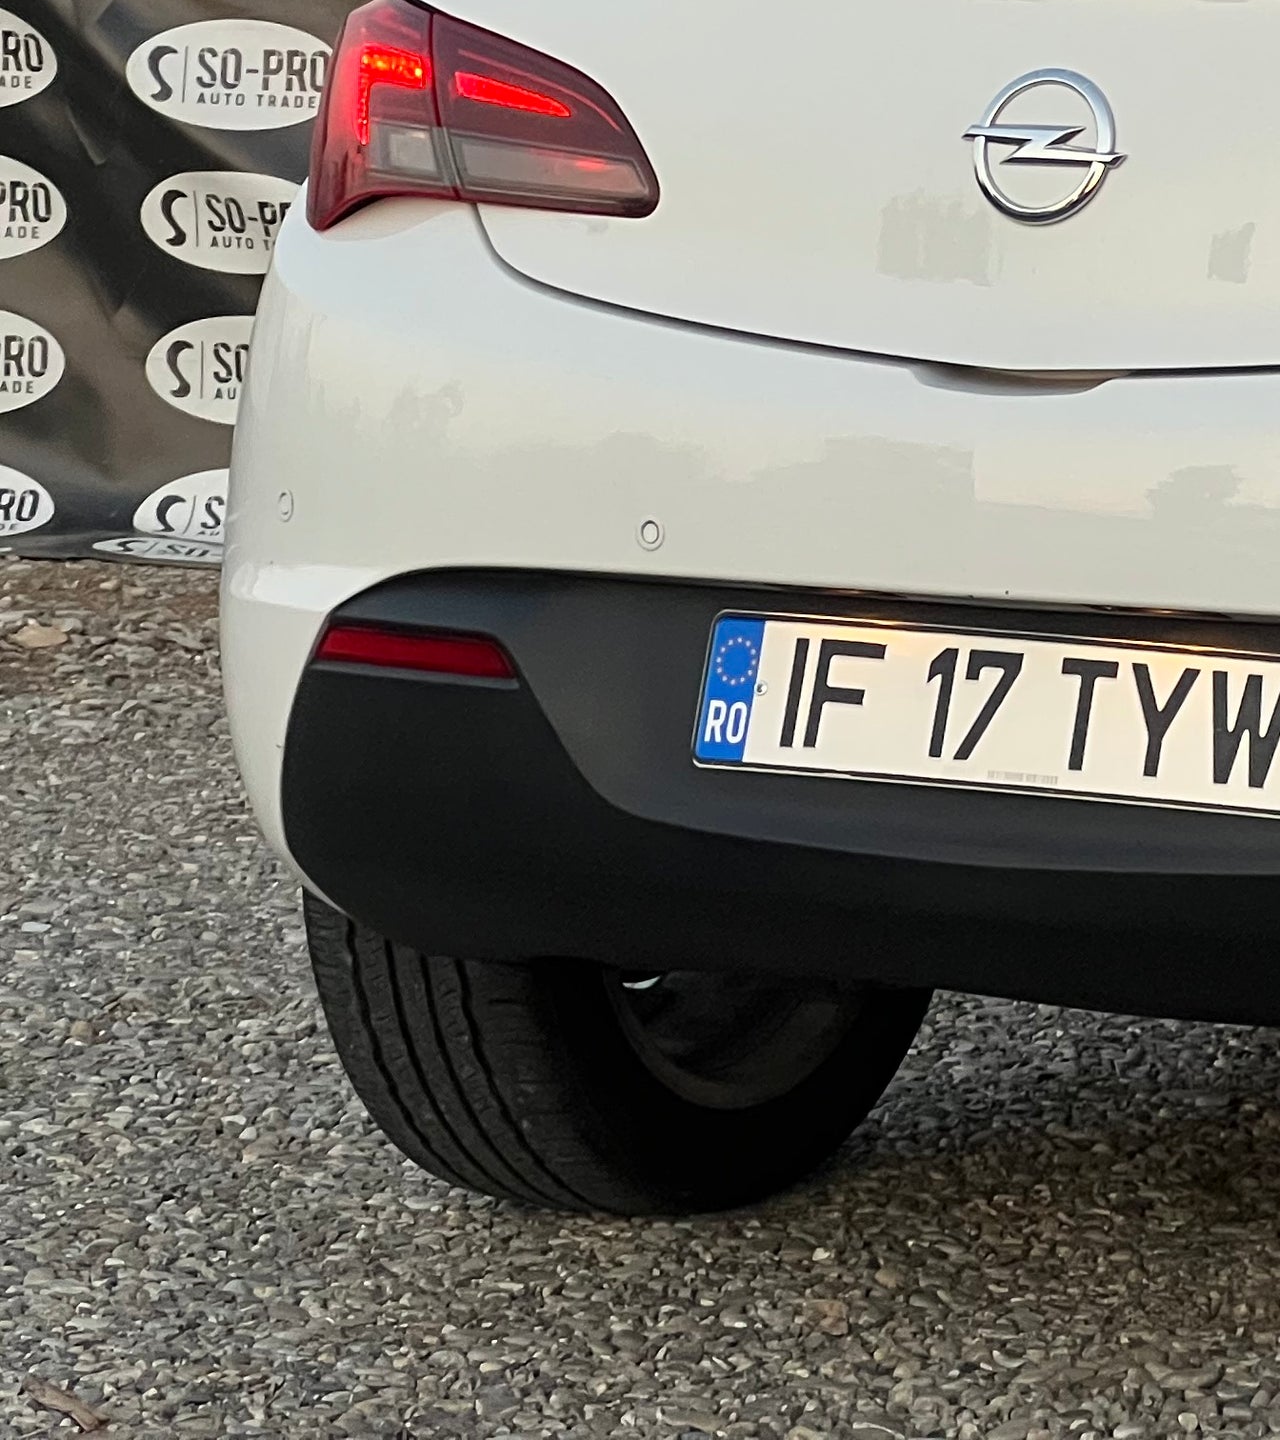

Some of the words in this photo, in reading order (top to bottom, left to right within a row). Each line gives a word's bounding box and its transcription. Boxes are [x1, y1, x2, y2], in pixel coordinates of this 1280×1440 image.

[196, 48, 328, 93] SO-PRO
[197, 93, 245, 106] AUTO
[257, 94, 316, 108] TRADE
[211, 236, 254, 249] AUTO
[704, 699, 748, 744] RO
[780, 638, 887, 748] IF
[926, 646, 1025, 760] 17
